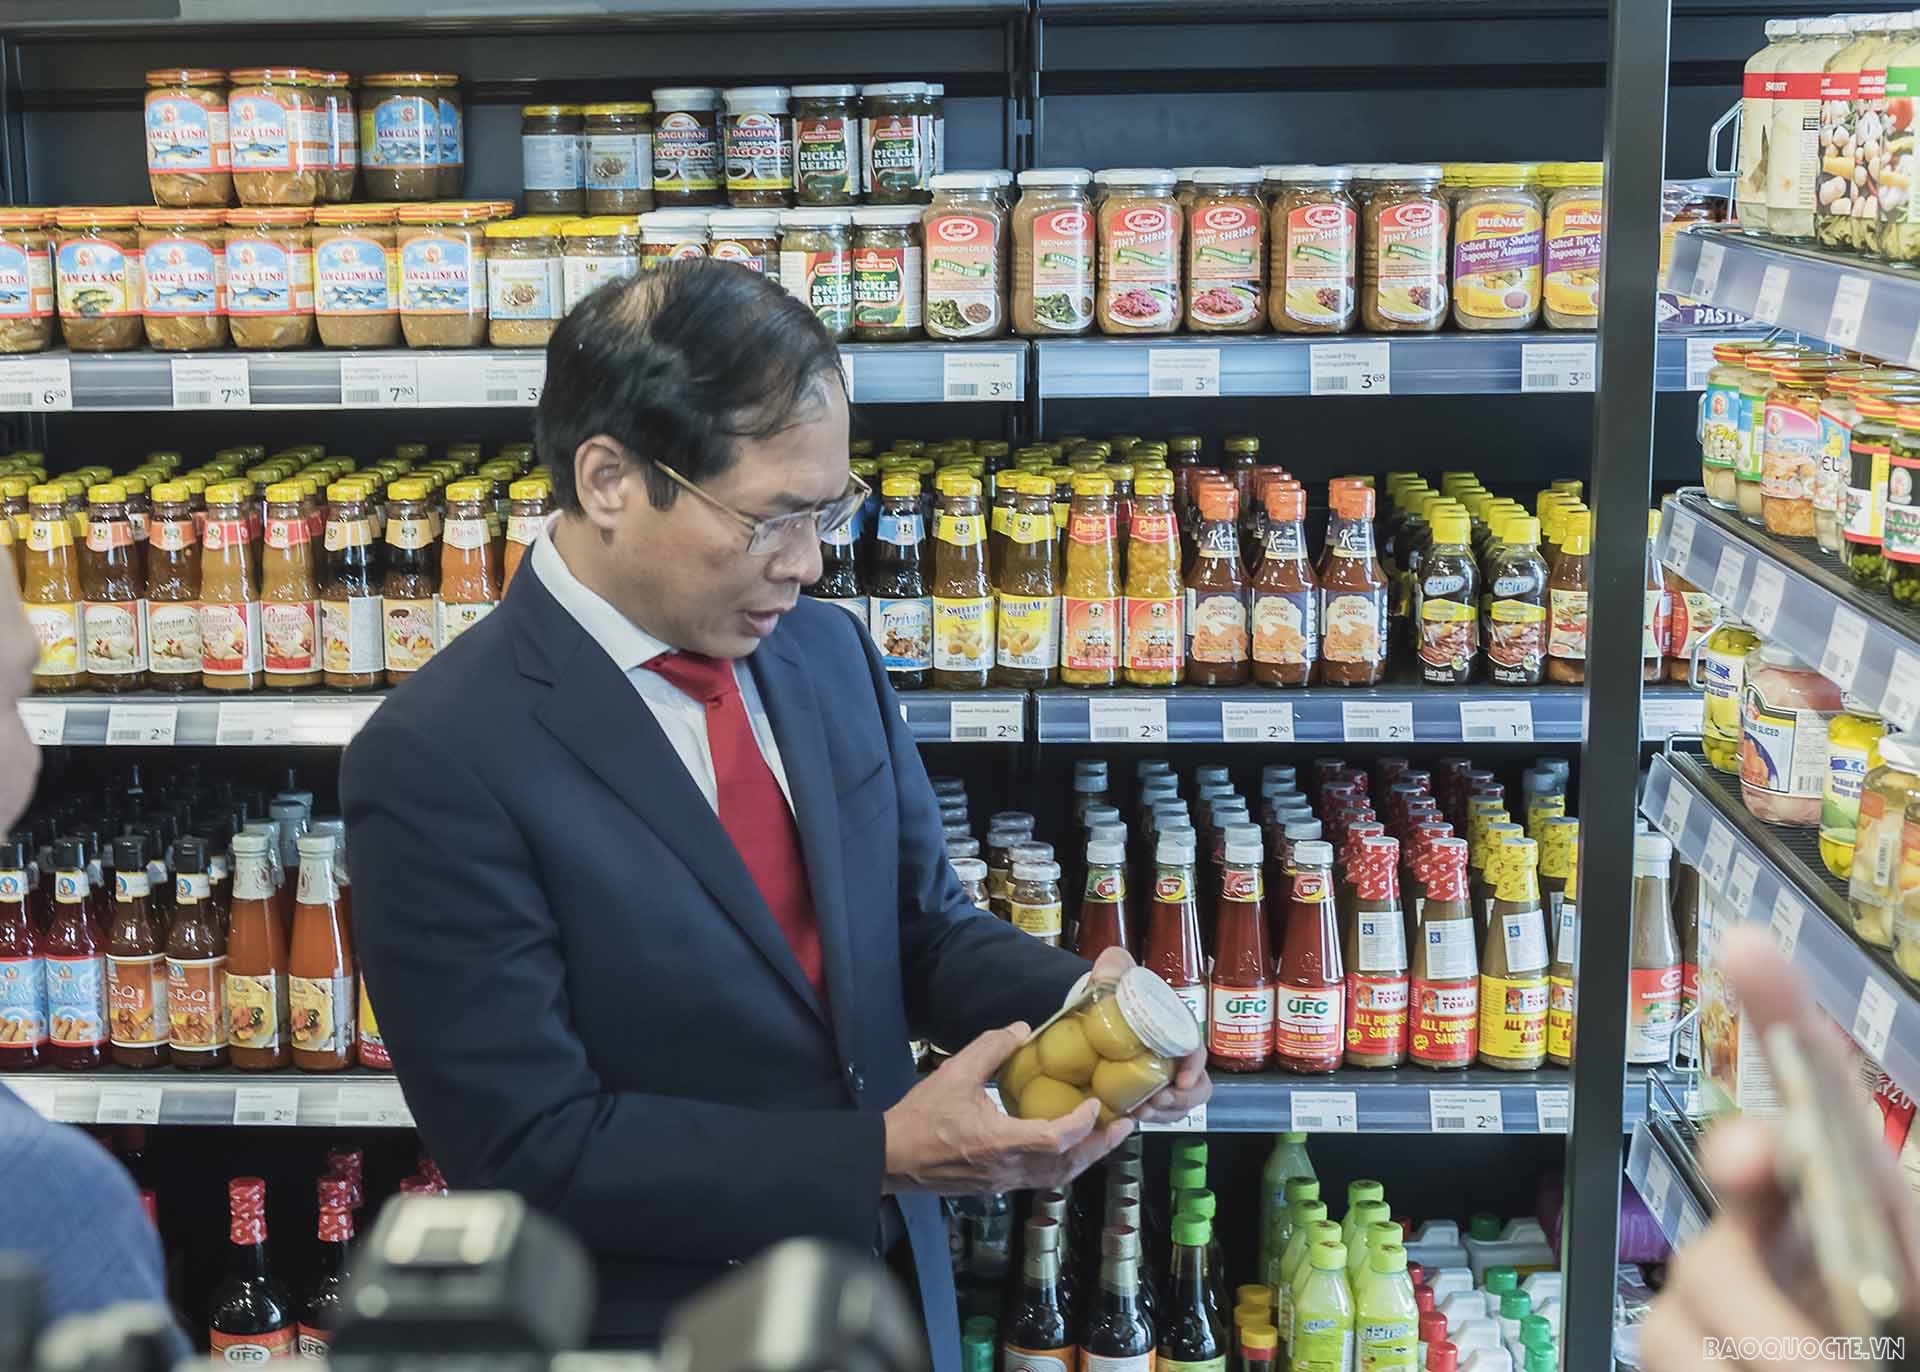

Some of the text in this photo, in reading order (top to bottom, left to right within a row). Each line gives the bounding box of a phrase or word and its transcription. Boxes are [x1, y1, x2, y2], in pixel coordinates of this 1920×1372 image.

[800, 151, 845, 162] PICKLE
[800, 161, 846, 171] RELISH
[874, 159, 914, 169] RELIS
[1113, 229, 1174, 249] TINY SHRIMP
[1195, 224, 1256, 246] TINY SHRIMP
[1293, 232, 1317, 244] TINY
[1383, 231, 1408, 243] TINY
[1460, 241, 1485, 253] Salted
[1488, 239, 1508, 251] Tiny
[1549, 235, 1596, 251] Salted Tiny
[1460, 250, 1499, 263] Bagoong
[1550, 247, 1587, 260] Bagoong
[1226, 999, 1267, 1014] UFC
[1287, 1000, 1329, 1015] UFC
[1355, 1013, 1373, 1026] ALL
[1420, 1018, 1438, 1032] ALL
[1504, 1019, 1521, 1031] ALL
[1369, 1027, 1400, 1039] SAUCE
[1435, 1032, 1466, 1045] SAUCE
[230, 1350, 264, 1362] UFC
